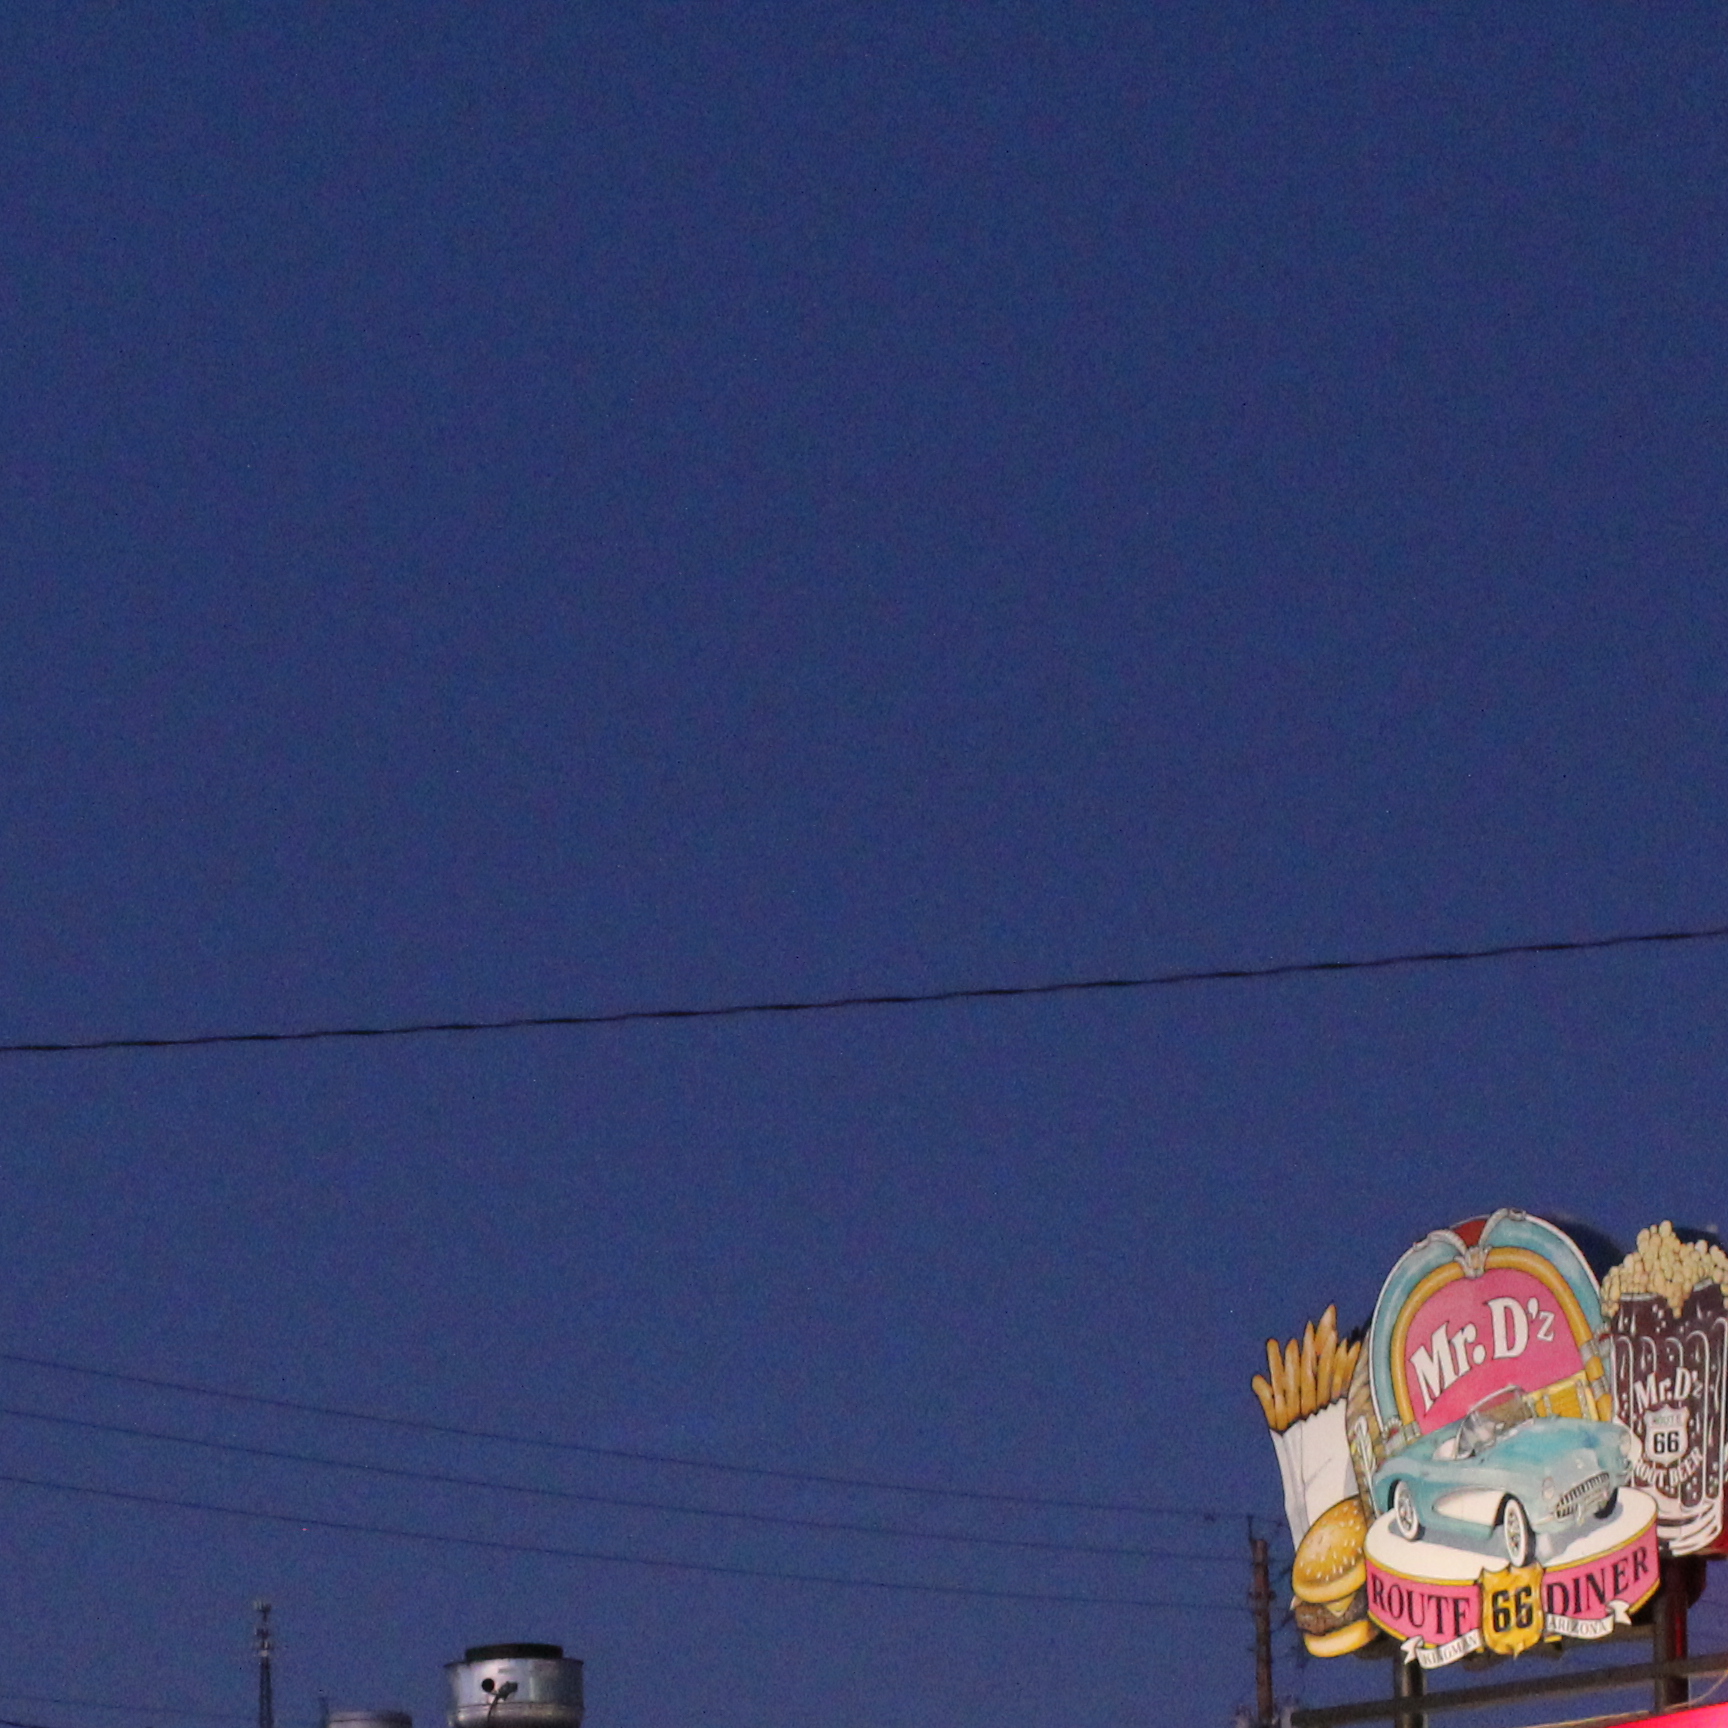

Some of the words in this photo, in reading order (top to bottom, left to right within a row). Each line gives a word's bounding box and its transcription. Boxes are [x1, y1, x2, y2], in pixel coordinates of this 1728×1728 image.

[1410, 1321, 1486, 1411] Mr.
[1483, 1297, 1556, 1360] D'z
[1634, 1372, 1672, 1414] Mr.
[1674, 1367, 1704, 1399] D'z
[1653, 1431, 1679, 1454] 66
[1669, 1446, 1704, 1487] BEER
[1371, 1574, 1471, 1636] ROUTE
[1491, 1584, 1533, 1633] 66
[1546, 1546, 1649, 1616] DINER
[1422, 1634, 1477, 1665] KINGMAN
[1548, 1613, 1609, 1635] ARIZONA
